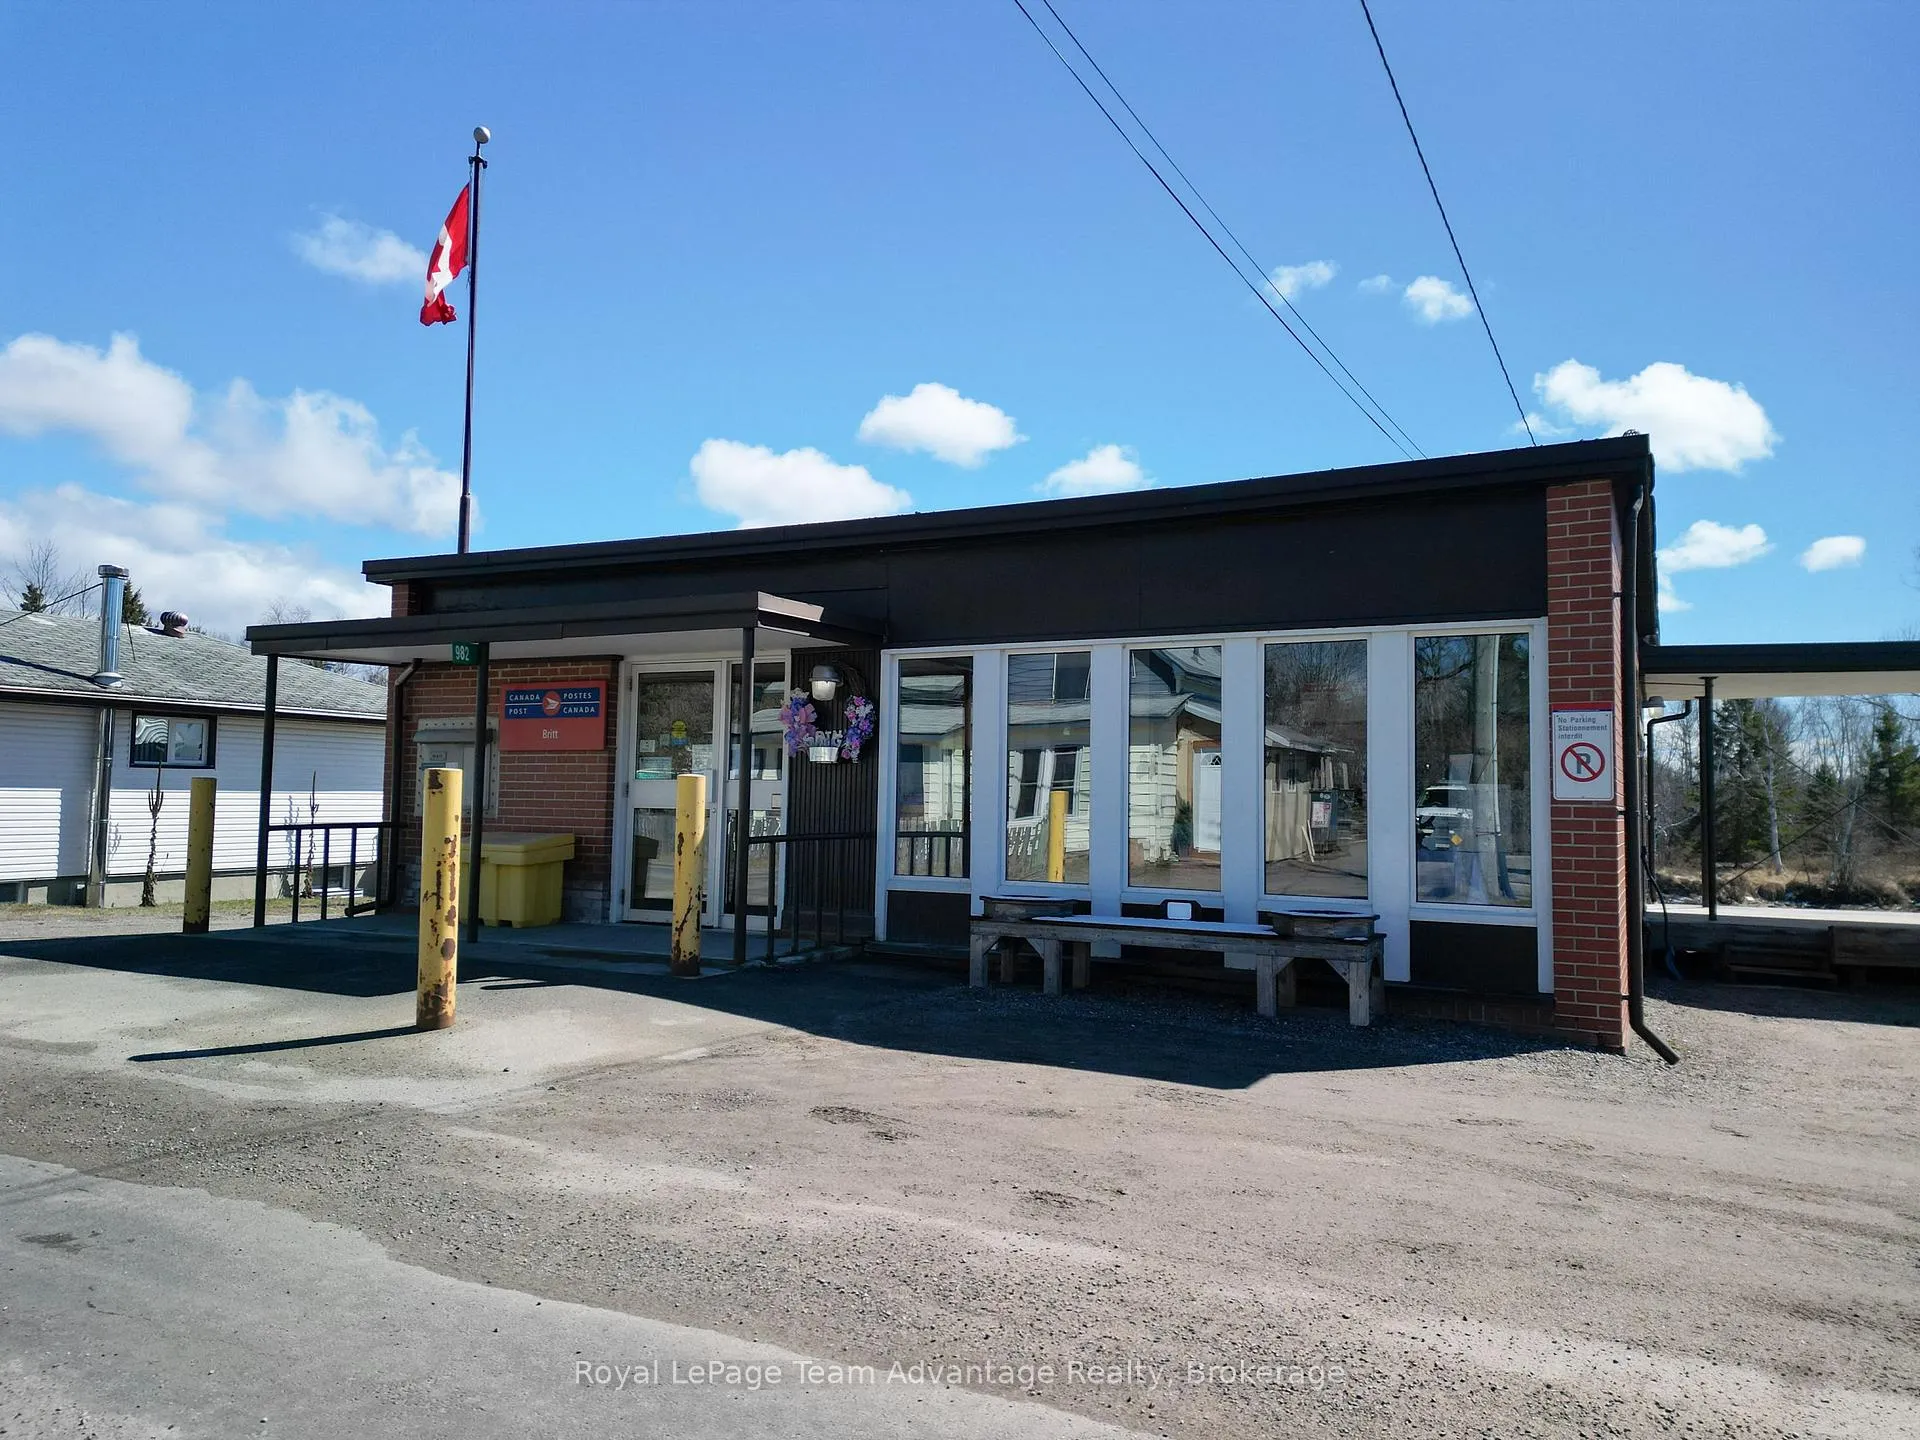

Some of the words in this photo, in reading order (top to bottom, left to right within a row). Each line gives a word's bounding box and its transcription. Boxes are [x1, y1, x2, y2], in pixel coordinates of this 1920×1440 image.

[455, 644, 470, 661] 982
[509, 694, 540, 702] CANADA
[563, 692, 592, 700] POSTES
[563, 706, 595, 714] CANADA
[1570, 716, 1596, 724] Parking
[542, 729, 558, 739] Britt
